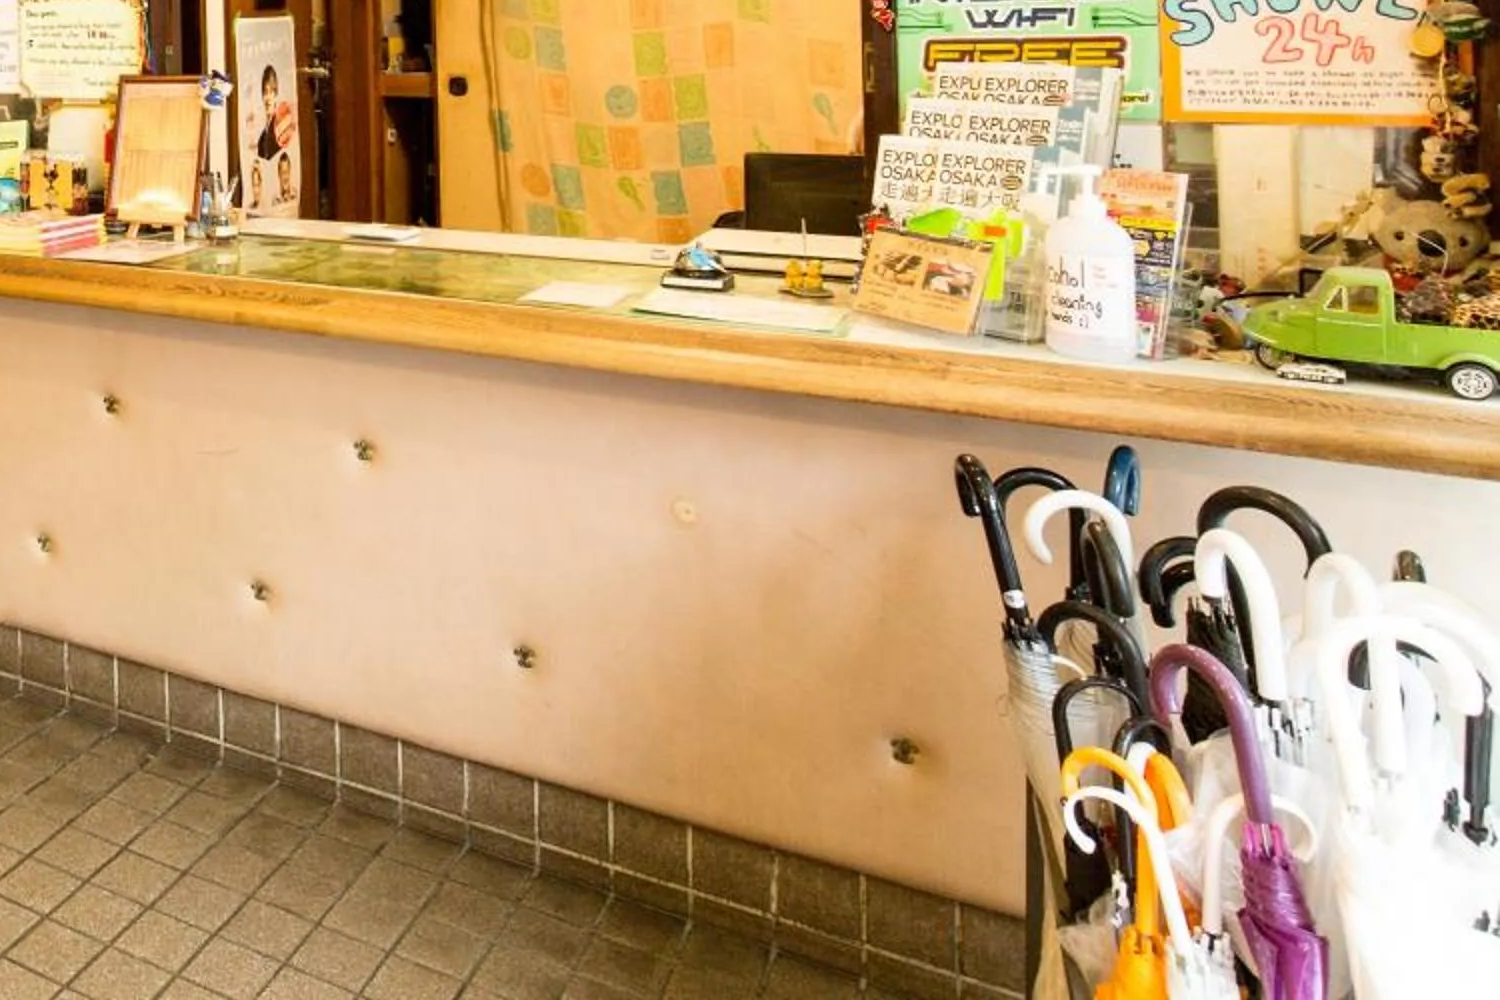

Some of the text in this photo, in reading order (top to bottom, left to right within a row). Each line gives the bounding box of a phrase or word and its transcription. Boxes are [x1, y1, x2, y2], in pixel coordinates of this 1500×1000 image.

[985, 76, 1071, 94] EXPLORER
[911, 110, 1051, 135] EXPLO EXPLORER
[883, 149, 1027, 175] EXPLO EXPLORER
[938, 169, 998, 190] OSAKA
